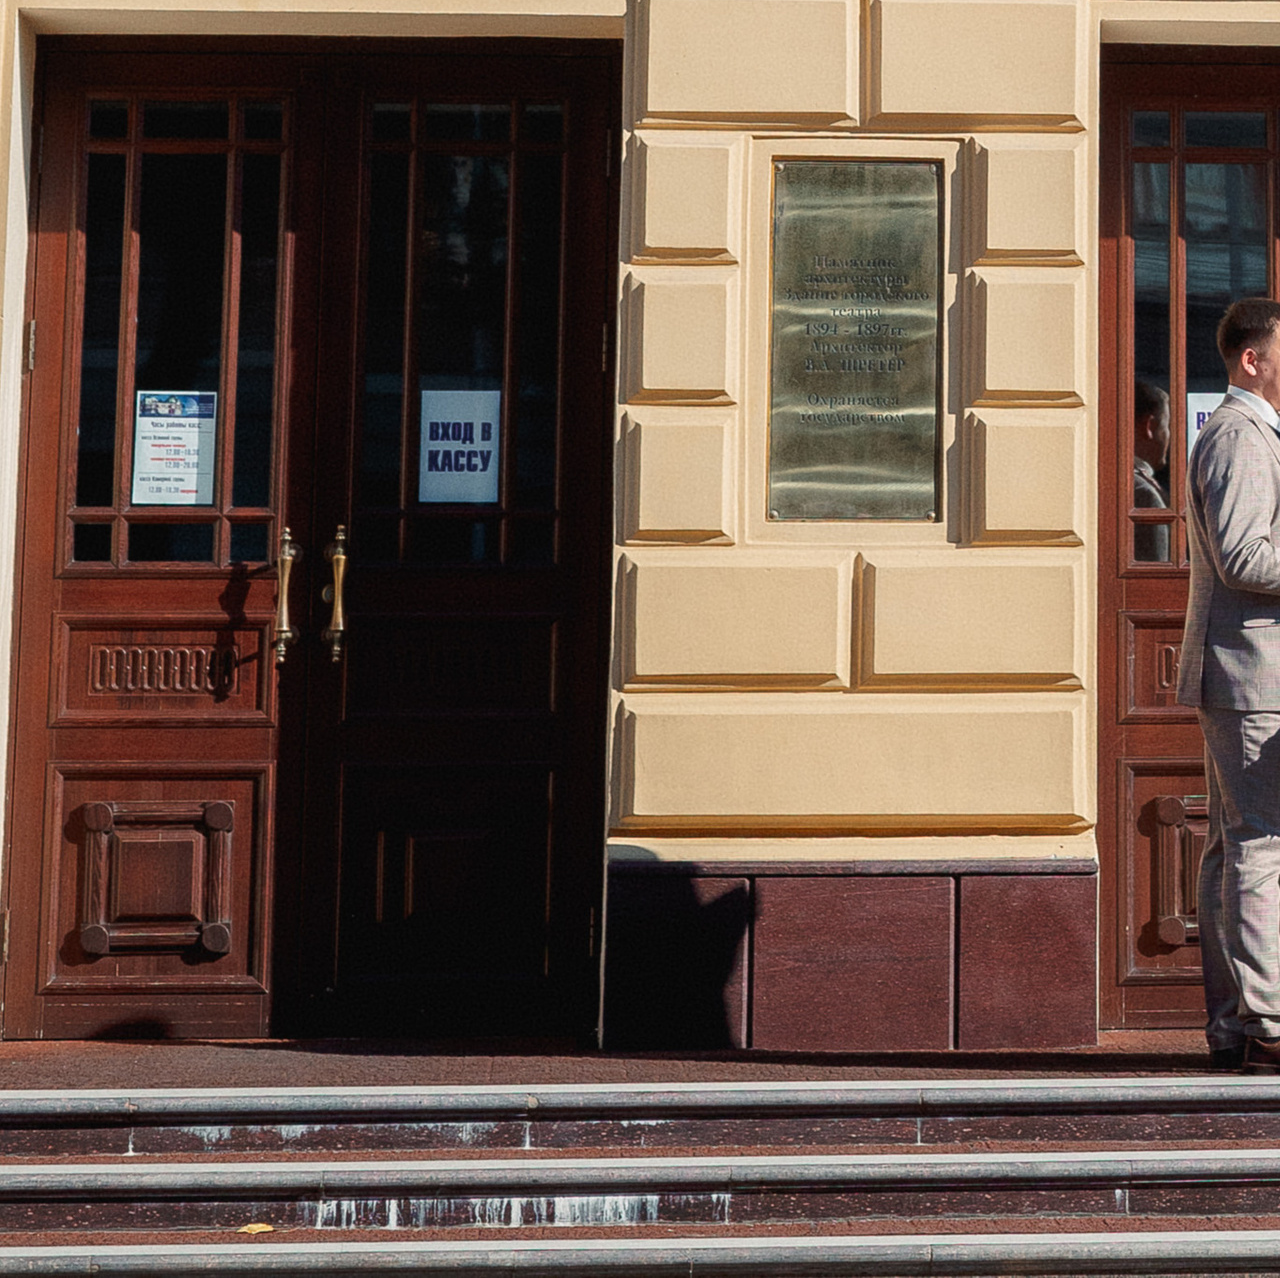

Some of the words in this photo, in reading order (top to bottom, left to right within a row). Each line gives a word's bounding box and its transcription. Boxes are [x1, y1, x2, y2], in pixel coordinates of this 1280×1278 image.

[814, 255, 897, 269] Памятник
[804, 273, 909, 288] архитектуры
[831, 308, 882, 319] театра
[805, 322, 838, 336] 1894
[809, 339, 903, 355] Архитектор
[807, 393, 900, 408] Охраняется
[801, 412, 906, 425] государством
[429, 421, 474, 444] ВХОД
[481, 422, 492, 442] В
[428, 450, 492, 473] КАССУ
